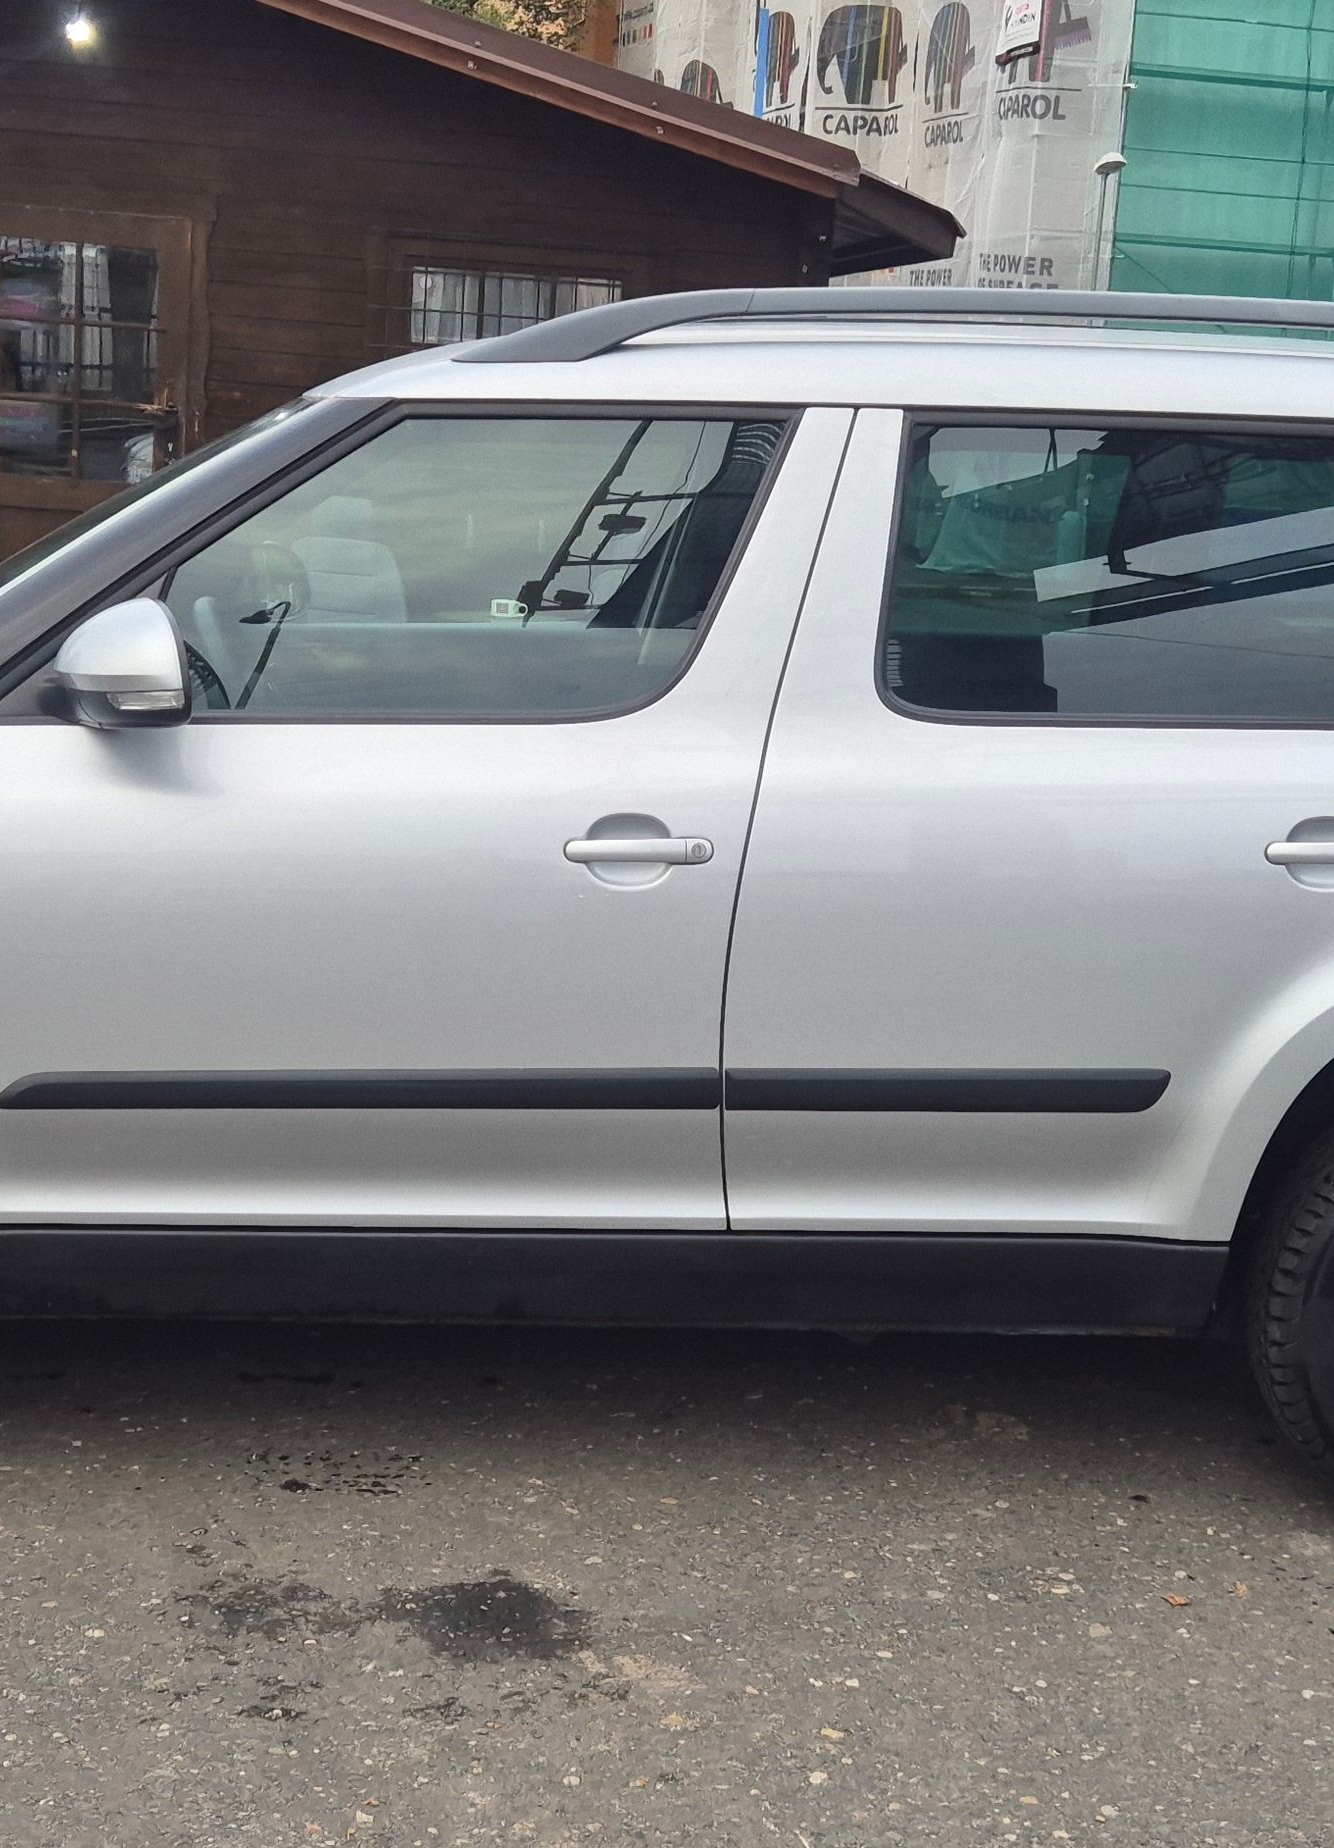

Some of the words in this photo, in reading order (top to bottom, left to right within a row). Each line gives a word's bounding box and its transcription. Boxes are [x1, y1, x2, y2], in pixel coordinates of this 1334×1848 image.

[979, 252, 992, 273] THE
[993, 253, 1054, 277] POWER
[910, 269, 925, 287] THE
[926, 268, 953, 288] POWER
